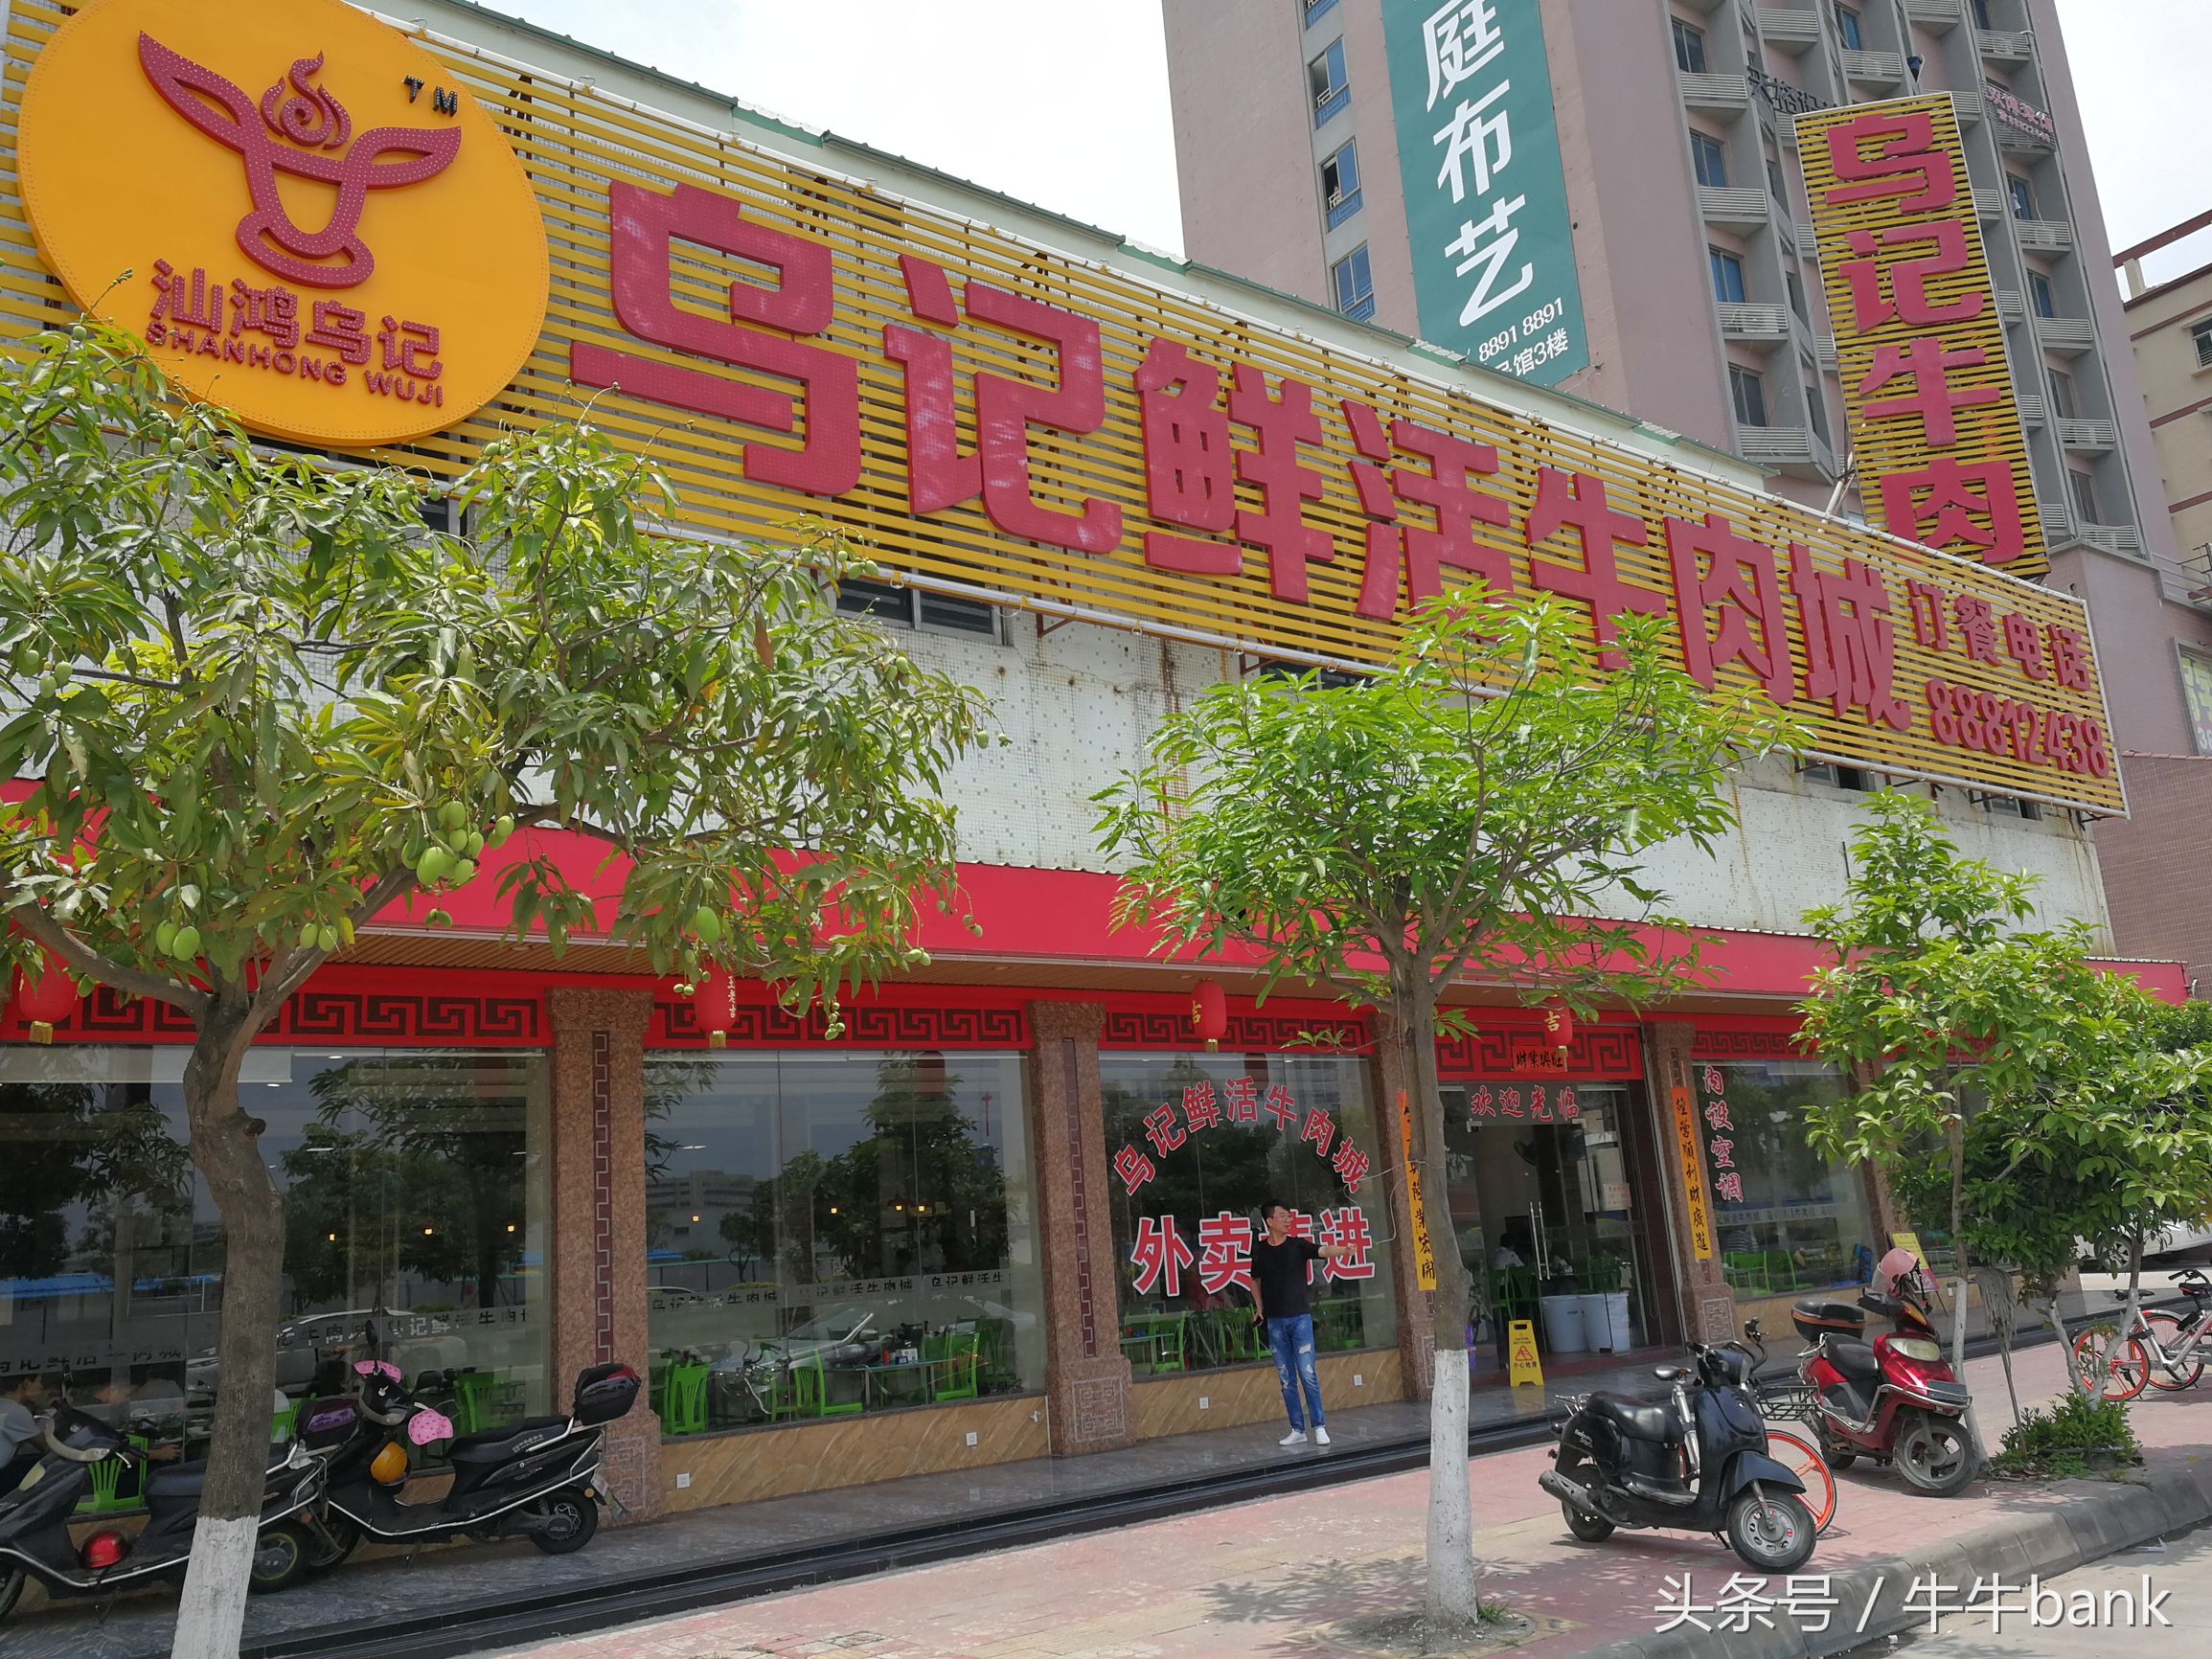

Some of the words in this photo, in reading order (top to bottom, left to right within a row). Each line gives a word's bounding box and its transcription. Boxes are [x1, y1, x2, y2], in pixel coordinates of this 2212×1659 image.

[402, 75, 458, 117] TM
[146, 321, 347, 386] SHANHONG
[364, 370, 443, 407] WUJI
[149, 258, 443, 381] 汕鸿乌记
[1478, 325, 1517, 362] 8891
[1522, 297, 1563, 336] 8891
[1825, 112, 2024, 565] 乌记牛肉
[570, 180, 1911, 732] 乌记鲜活牛肉城
[1904, 579, 2090, 692] 订餐电话
[1926, 678, 2109, 779] 88812438
[1113, 1076, 1370, 1196] 乌记鲜活牛肉城
[1471, 1084, 1579, 1122] 欢迎光临
[1704, 1064, 1745, 1203] 内设空调
